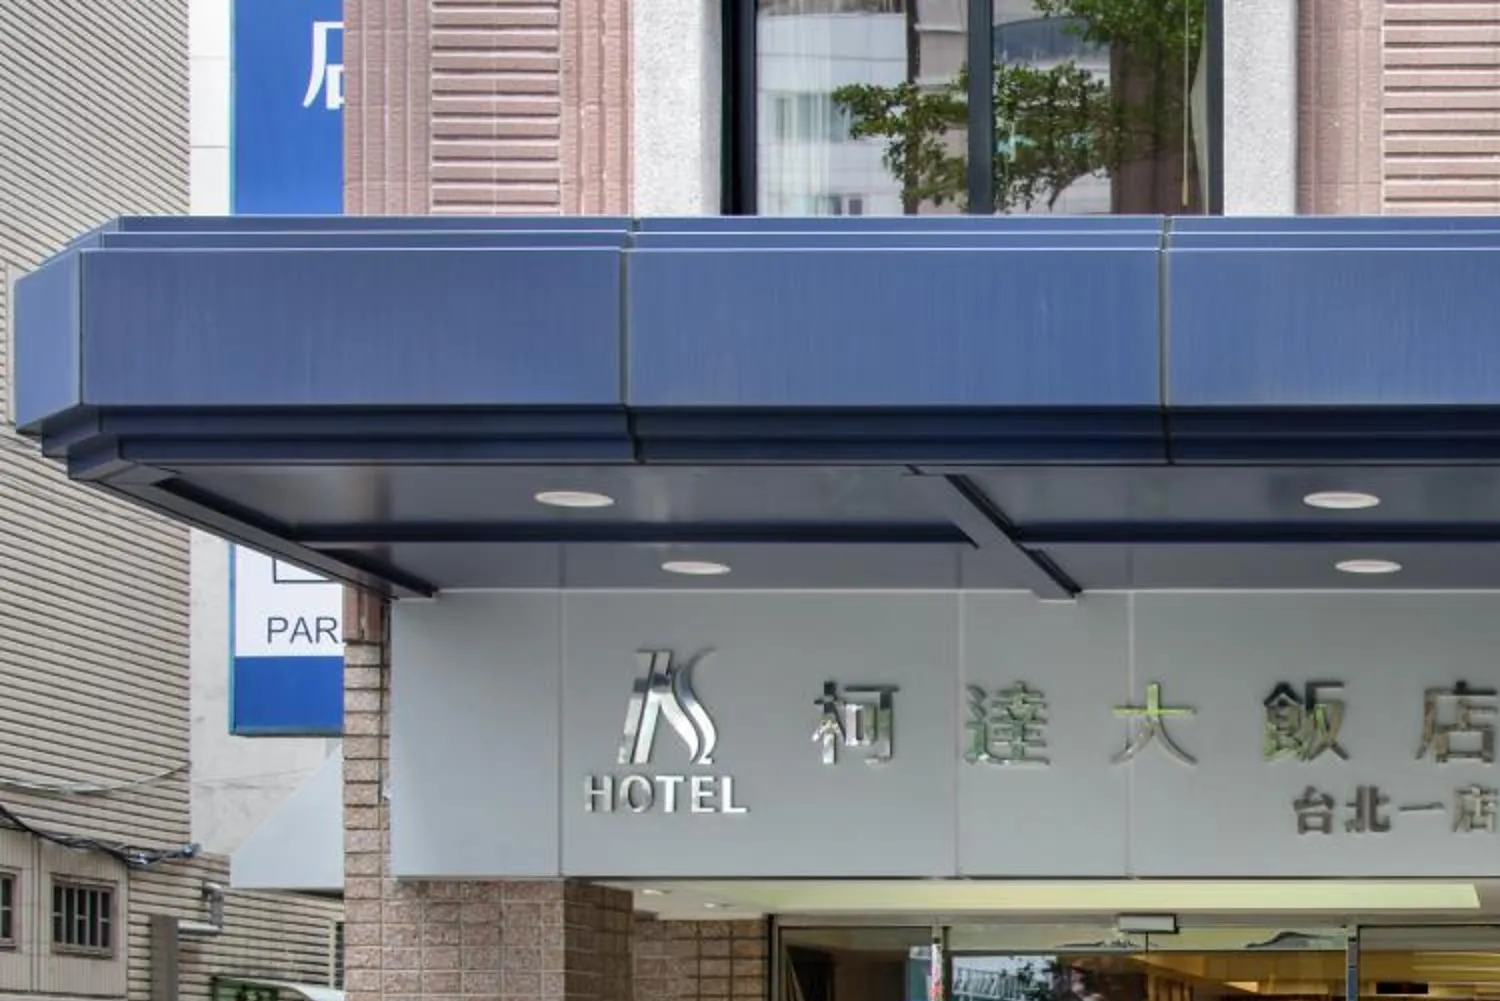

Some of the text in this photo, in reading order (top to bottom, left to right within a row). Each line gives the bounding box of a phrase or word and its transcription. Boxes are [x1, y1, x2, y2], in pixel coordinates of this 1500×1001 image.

[811, 679, 1498, 764] 柯達大飯店
[584, 774, 749, 814] HOTEL
[1293, 784, 1499, 835] 台北一店
